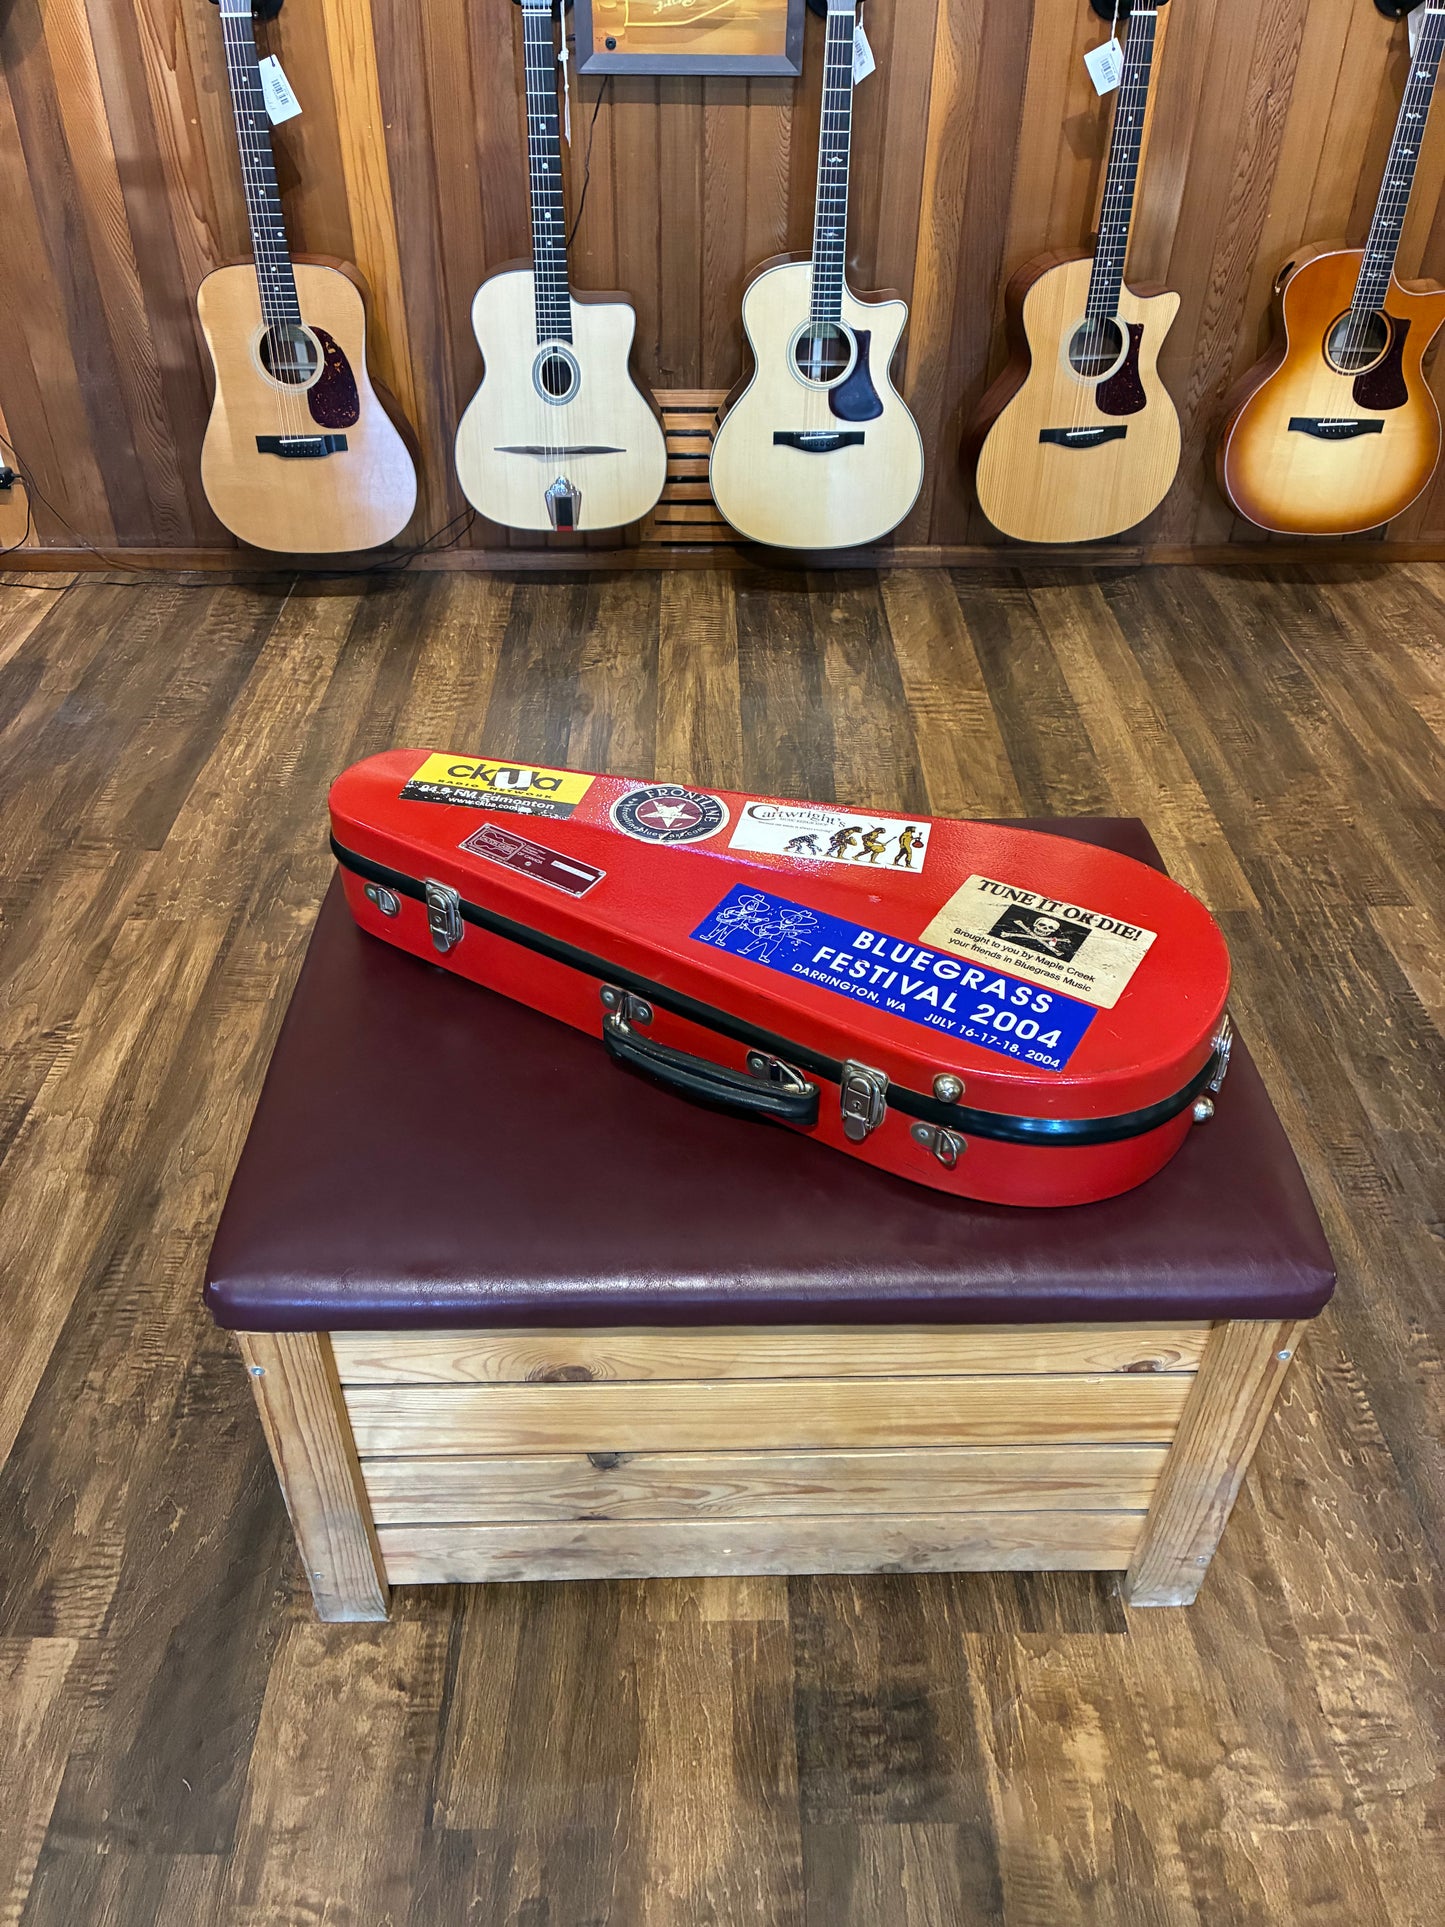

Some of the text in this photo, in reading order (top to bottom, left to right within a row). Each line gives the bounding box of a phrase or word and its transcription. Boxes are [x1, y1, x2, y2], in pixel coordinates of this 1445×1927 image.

[438, 779, 552, 799] RADIO NETWORK
[447, 764, 563, 791] ckua
[479, 792, 555, 810] Edmonton
[645, 788, 720, 823] FRONTLINE
[747, 804, 846, 828] Cartwright's
[977, 879, 1143, 942] TUNE IT OR DIE!
[851, 930, 1053, 1014] BLUEGRASS
[948, 937, 1092, 993] your friends in Bluegrass Music
[953, 927, 1097, 983] Brought to you by Maple Creek
[791, 963, 1061, 1068] DARRINGTON, WA JULY 16-17-18, 2004
[811, 946, 1062, 1049] FESTIVAL 2004
